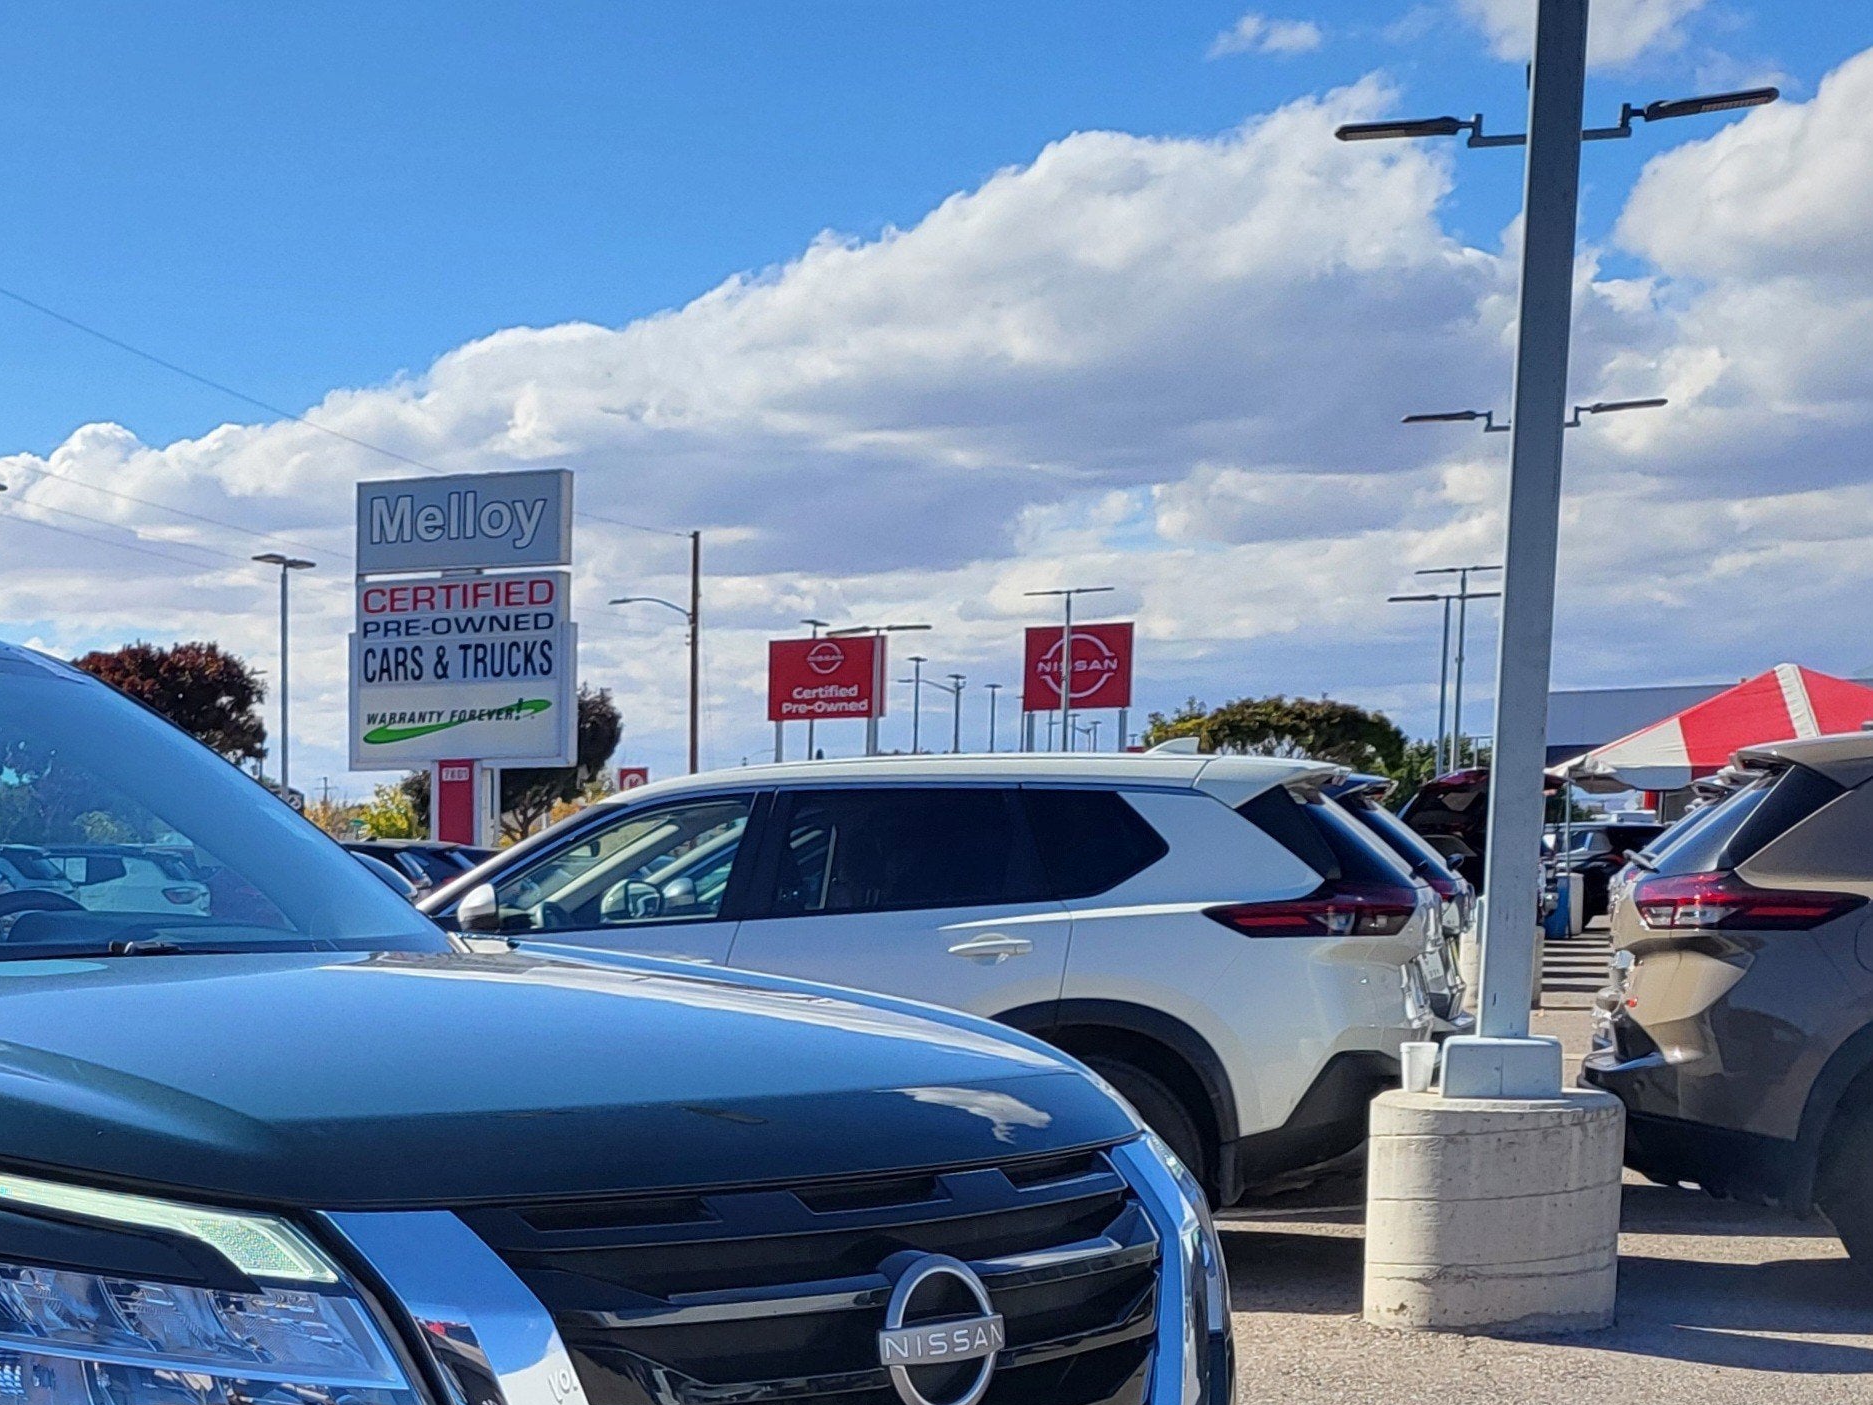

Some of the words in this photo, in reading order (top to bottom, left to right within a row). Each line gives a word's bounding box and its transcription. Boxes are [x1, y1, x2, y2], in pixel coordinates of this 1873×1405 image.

[370, 490, 548, 549] Melloy
[363, 580, 554, 613] CERTIFIED
[363, 613, 554, 638] PRE-OWNED
[364, 645, 423, 683] CARS
[433, 645, 449, 680] &
[459, 639, 553, 678] TRUCKS
[1037, 658, 1118, 672] NISAN
[792, 684, 858, 699] Certified
[366, 710, 445, 725] WARRANTY
[782, 699, 868, 714] Pre-Owned
[884, 1323, 1004, 1359] NISSAN
